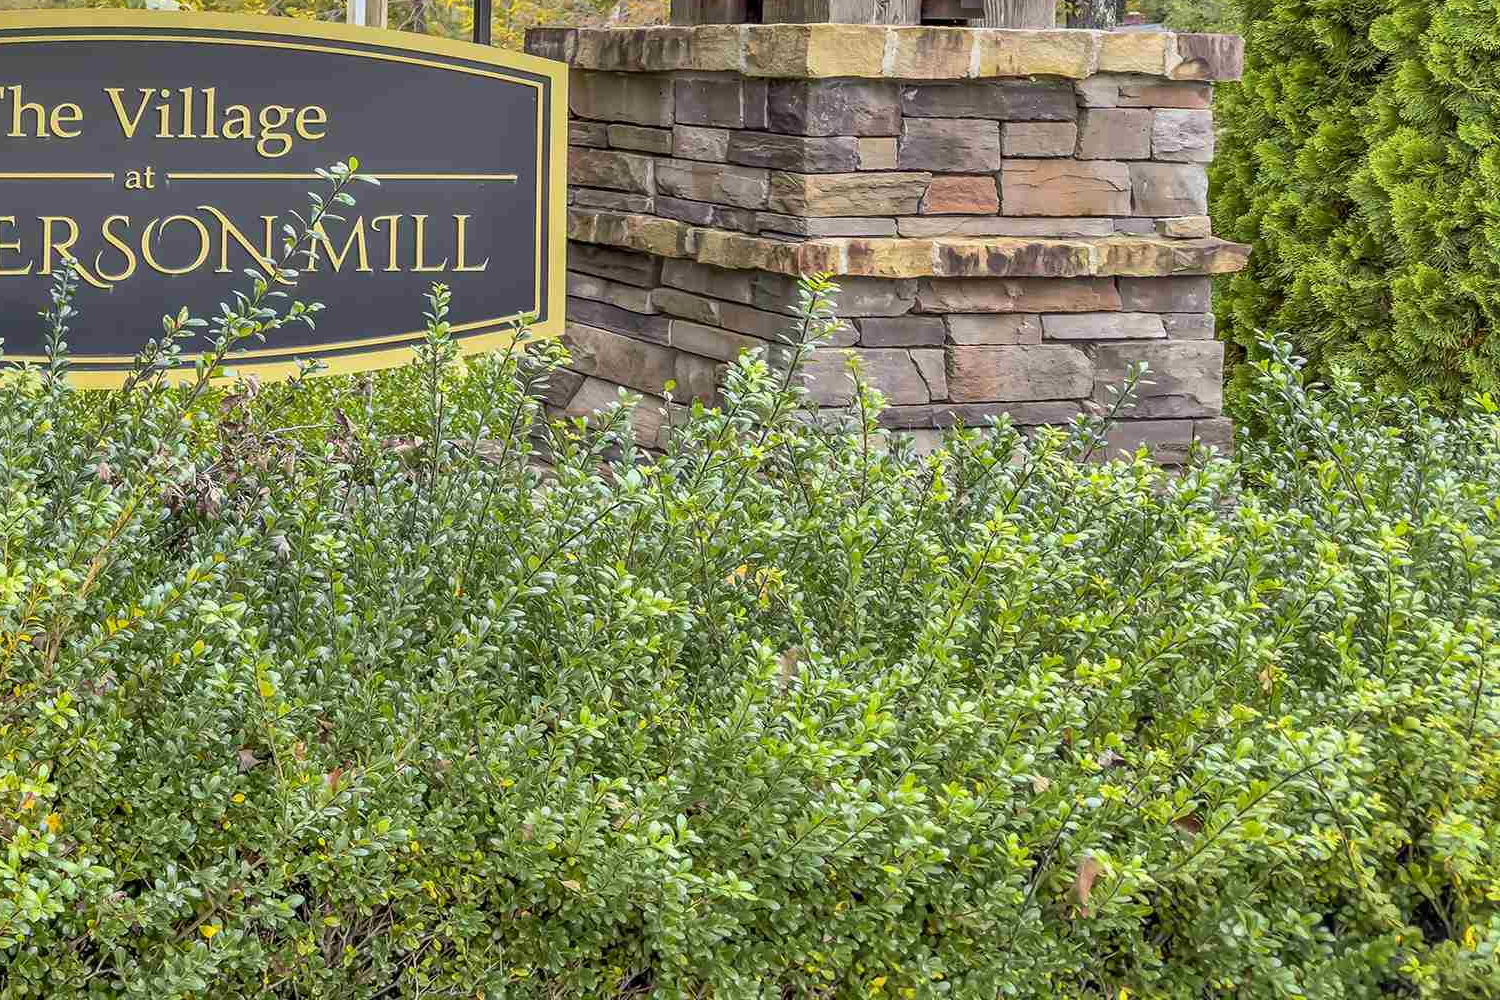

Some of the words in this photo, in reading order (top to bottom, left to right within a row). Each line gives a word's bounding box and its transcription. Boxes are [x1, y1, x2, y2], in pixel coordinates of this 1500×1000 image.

[103, 85, 328, 158] Village
[124, 166, 156, 190] at
[306, 213, 490, 273] MILL
